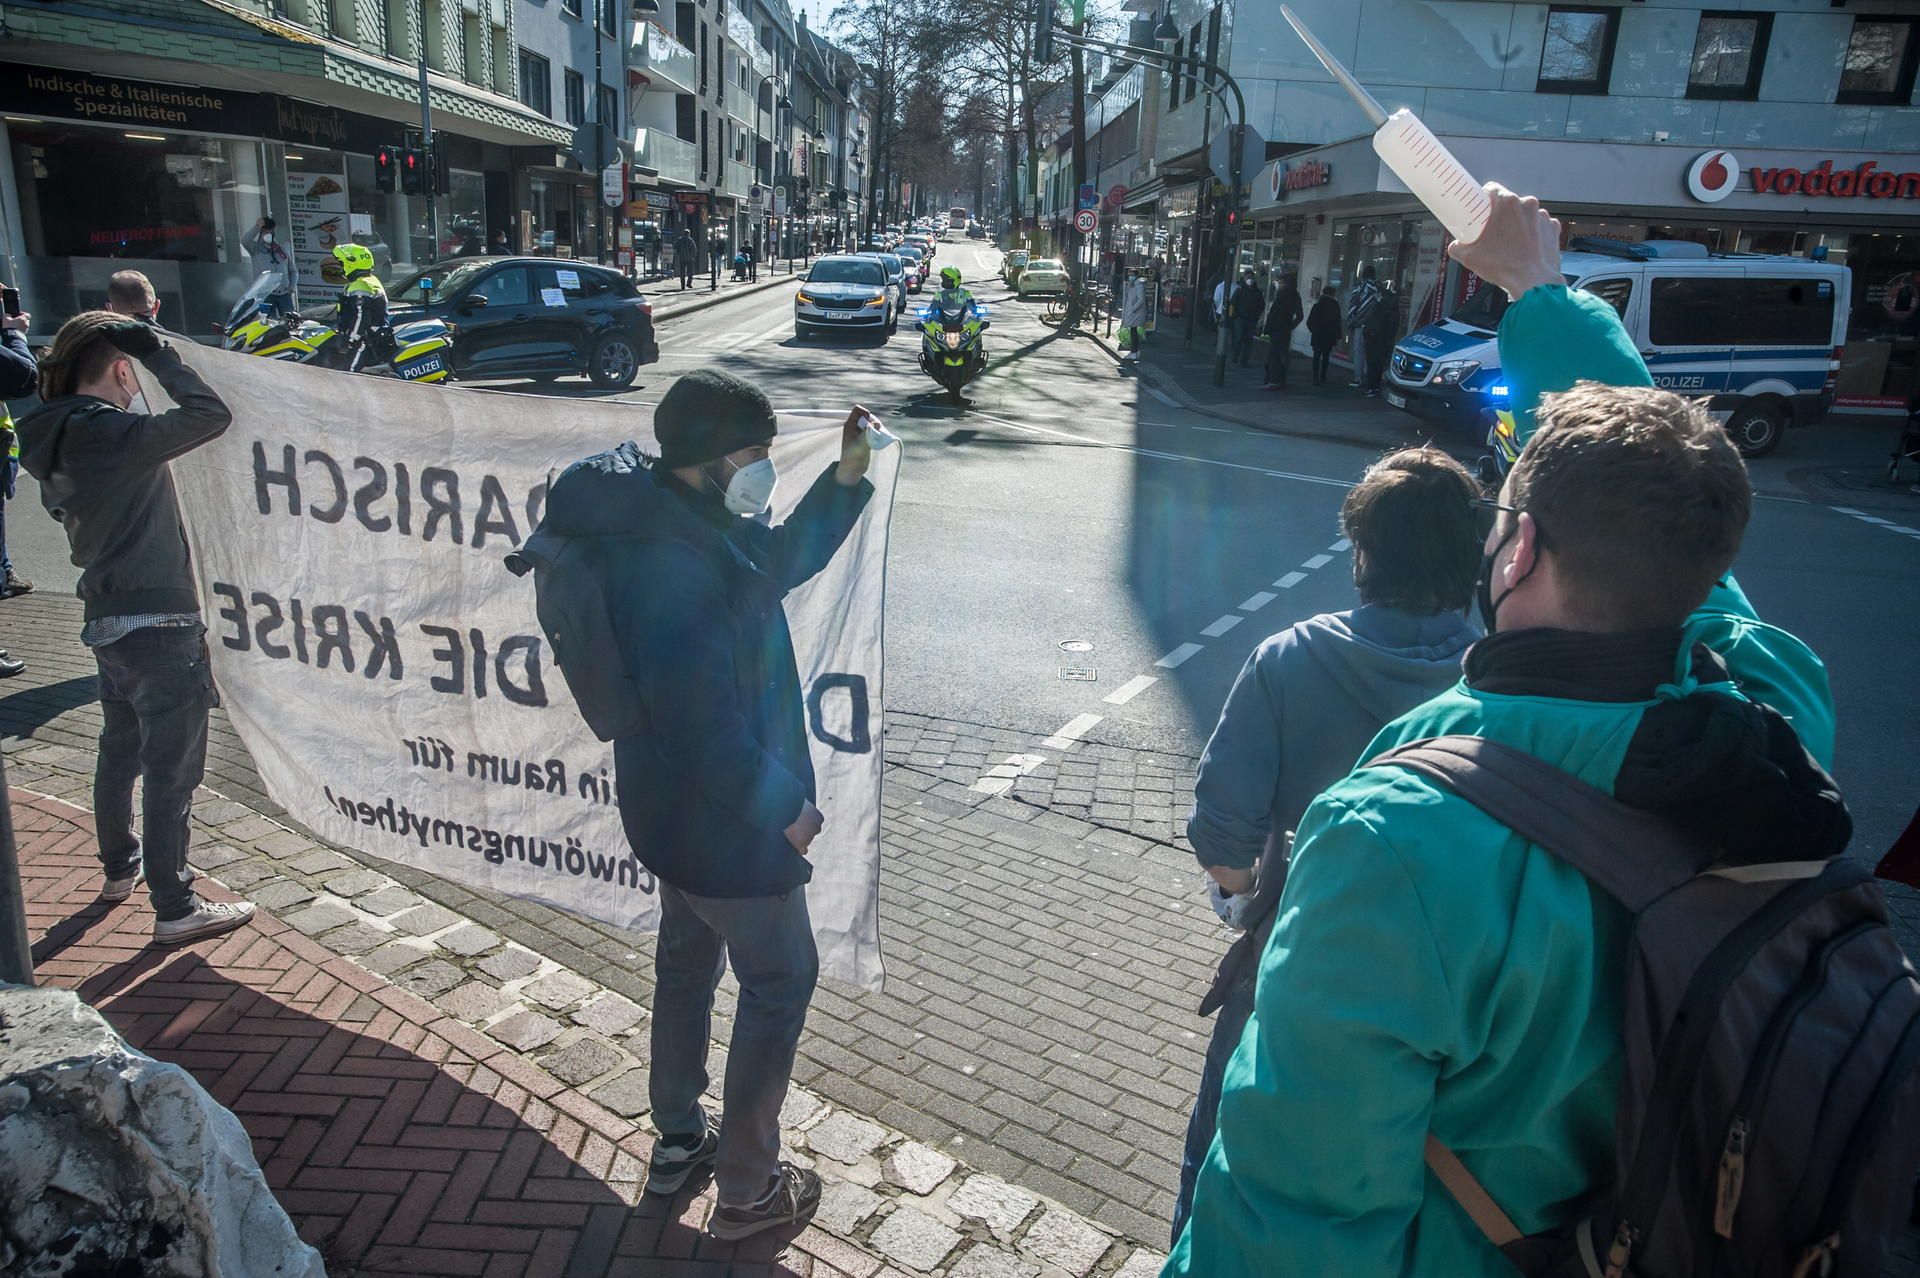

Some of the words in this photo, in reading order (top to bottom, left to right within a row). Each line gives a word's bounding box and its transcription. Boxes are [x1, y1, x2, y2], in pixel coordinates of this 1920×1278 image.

[27, 73, 105, 97] Indische
[110, 84, 123, 98] &
[128, 86, 223, 110] Italienische
[74, 97, 188, 123] Spezialitäten
[1080, 216, 1093, 227] 30
[1462, 271, 1477, 304] ness
[1409, 333, 1444, 349] POLIZEI
[404, 359, 440, 379] POLIZEI
[1653, 376, 1705, 388] POLIZEI
